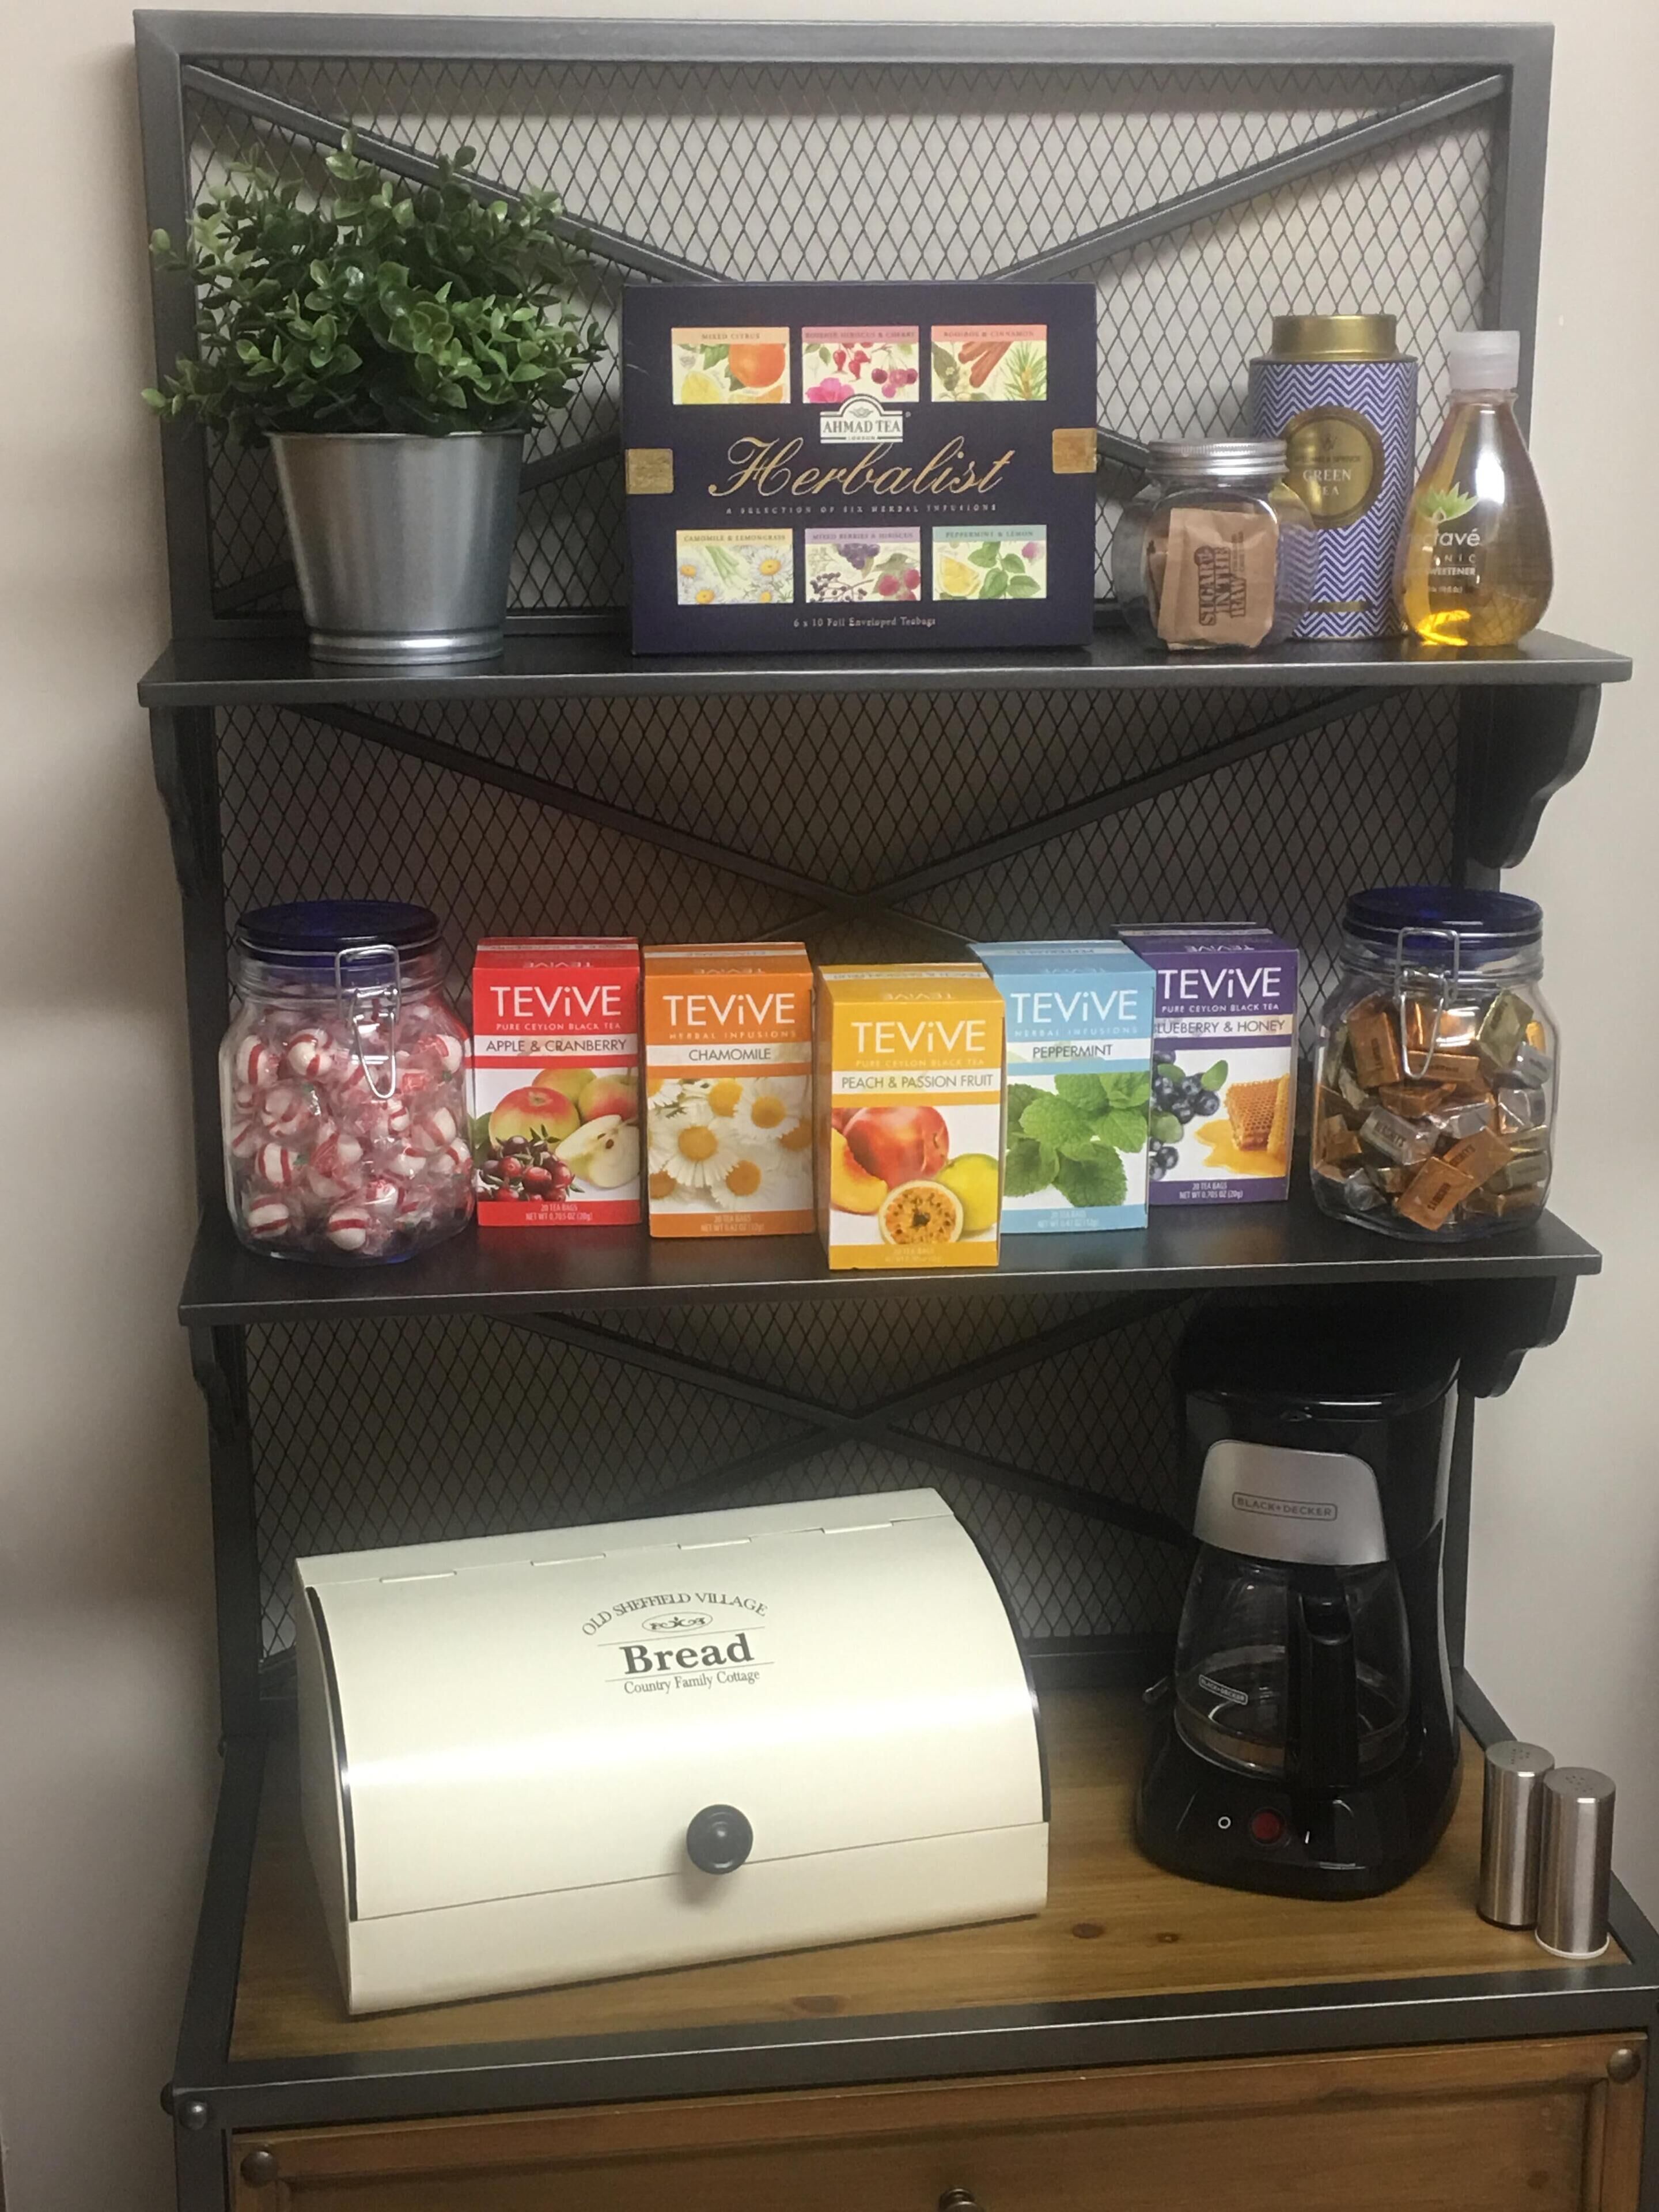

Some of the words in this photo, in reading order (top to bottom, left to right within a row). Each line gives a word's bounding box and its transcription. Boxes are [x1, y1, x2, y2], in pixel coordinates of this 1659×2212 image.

[823, 421, 873, 433] AHMAD
[876, 420, 901, 433] TEA
[708, 435, 1016, 497] Herbalist
[1302, 469, 1352, 482] GREEN
[740, 506, 812, 514] SELECTION
[843, 505, 863, 513] SIX
[926, 503, 997, 512] INFUSIONS
[1215, 547, 1230, 589] THE
[1199, 562, 1215, 626] SUGAR
[1230, 577, 1246, 618] RAW
[1215, 590, 1230, 613] IN
[793, 618, 800, 628] 6
[812, 618, 824, 627] 10
[827, 618, 846, 627] Foil
[849, 617, 897, 628] Enveloped
[900, 616, 937, 628] Teabags
[1162, 1005, 1184, 1014] PURE
[1189, 1004, 1226, 1013] CEYLON
[1230, 1003, 1259, 1012] BLACK
[1263, 1003, 1279, 1011] TEA
[496, 1022, 520, 1031] PURE
[524, 1022, 565, 1031] CEYLON
[569, 1022, 600, 1031] BLACK
[604, 1021, 622, 1030] TEA
[1014, 1029, 1060, 1037] HERBAL
[1069, 1026, 1138, 1036] INFUSIONS
[1224, 1021, 1233, 1032] &
[1237, 1019, 1286, 1032] HONEY
[724, 1030, 797, 1039] INFUSIONS
[486, 1040, 525, 1052] APPLE
[530, 1040, 541, 1052] &
[545, 1039, 627, 1052] CRANBERRY
[1033, 1044, 1113, 1059] PEPPERMINT
[688, 1048, 771, 1061] CHAMOMILE
[856, 1059, 880, 1067] PURE
[885, 1059, 926, 1067] CEYLON
[931, 1058, 961, 1066] BLACK
[967, 1058, 984, 1066] TEA
[842, 1076, 884, 1089] PEACH
[888, 1076, 897, 1088] &
[902, 1075, 957, 1088] PASSION
[960, 1074, 994, 1087] FRUIT
[1200, 1181, 1211, 1190] TEA
[1179, 1190, 1191, 1199] NET
[1192, 1190, 1201, 1199] WT
[550, 1203, 560, 1211] TEA
[525, 1212, 537, 1221] NET
[538, 1212, 547, 1220] WT
[1237, 1498, 1332, 1517] BLACK+DECKER
[582, 1611, 612, 1637] OLD
[612, 1593, 691, 1616] SHEFFIELD
[695, 1592, 768, 1617] VILLAGE
[619, 1632, 755, 1675] Bread
[624, 1680, 671, 1694] Country
[674, 1673, 713, 1690] Family
[717, 1670, 760, 1684] Cottage
